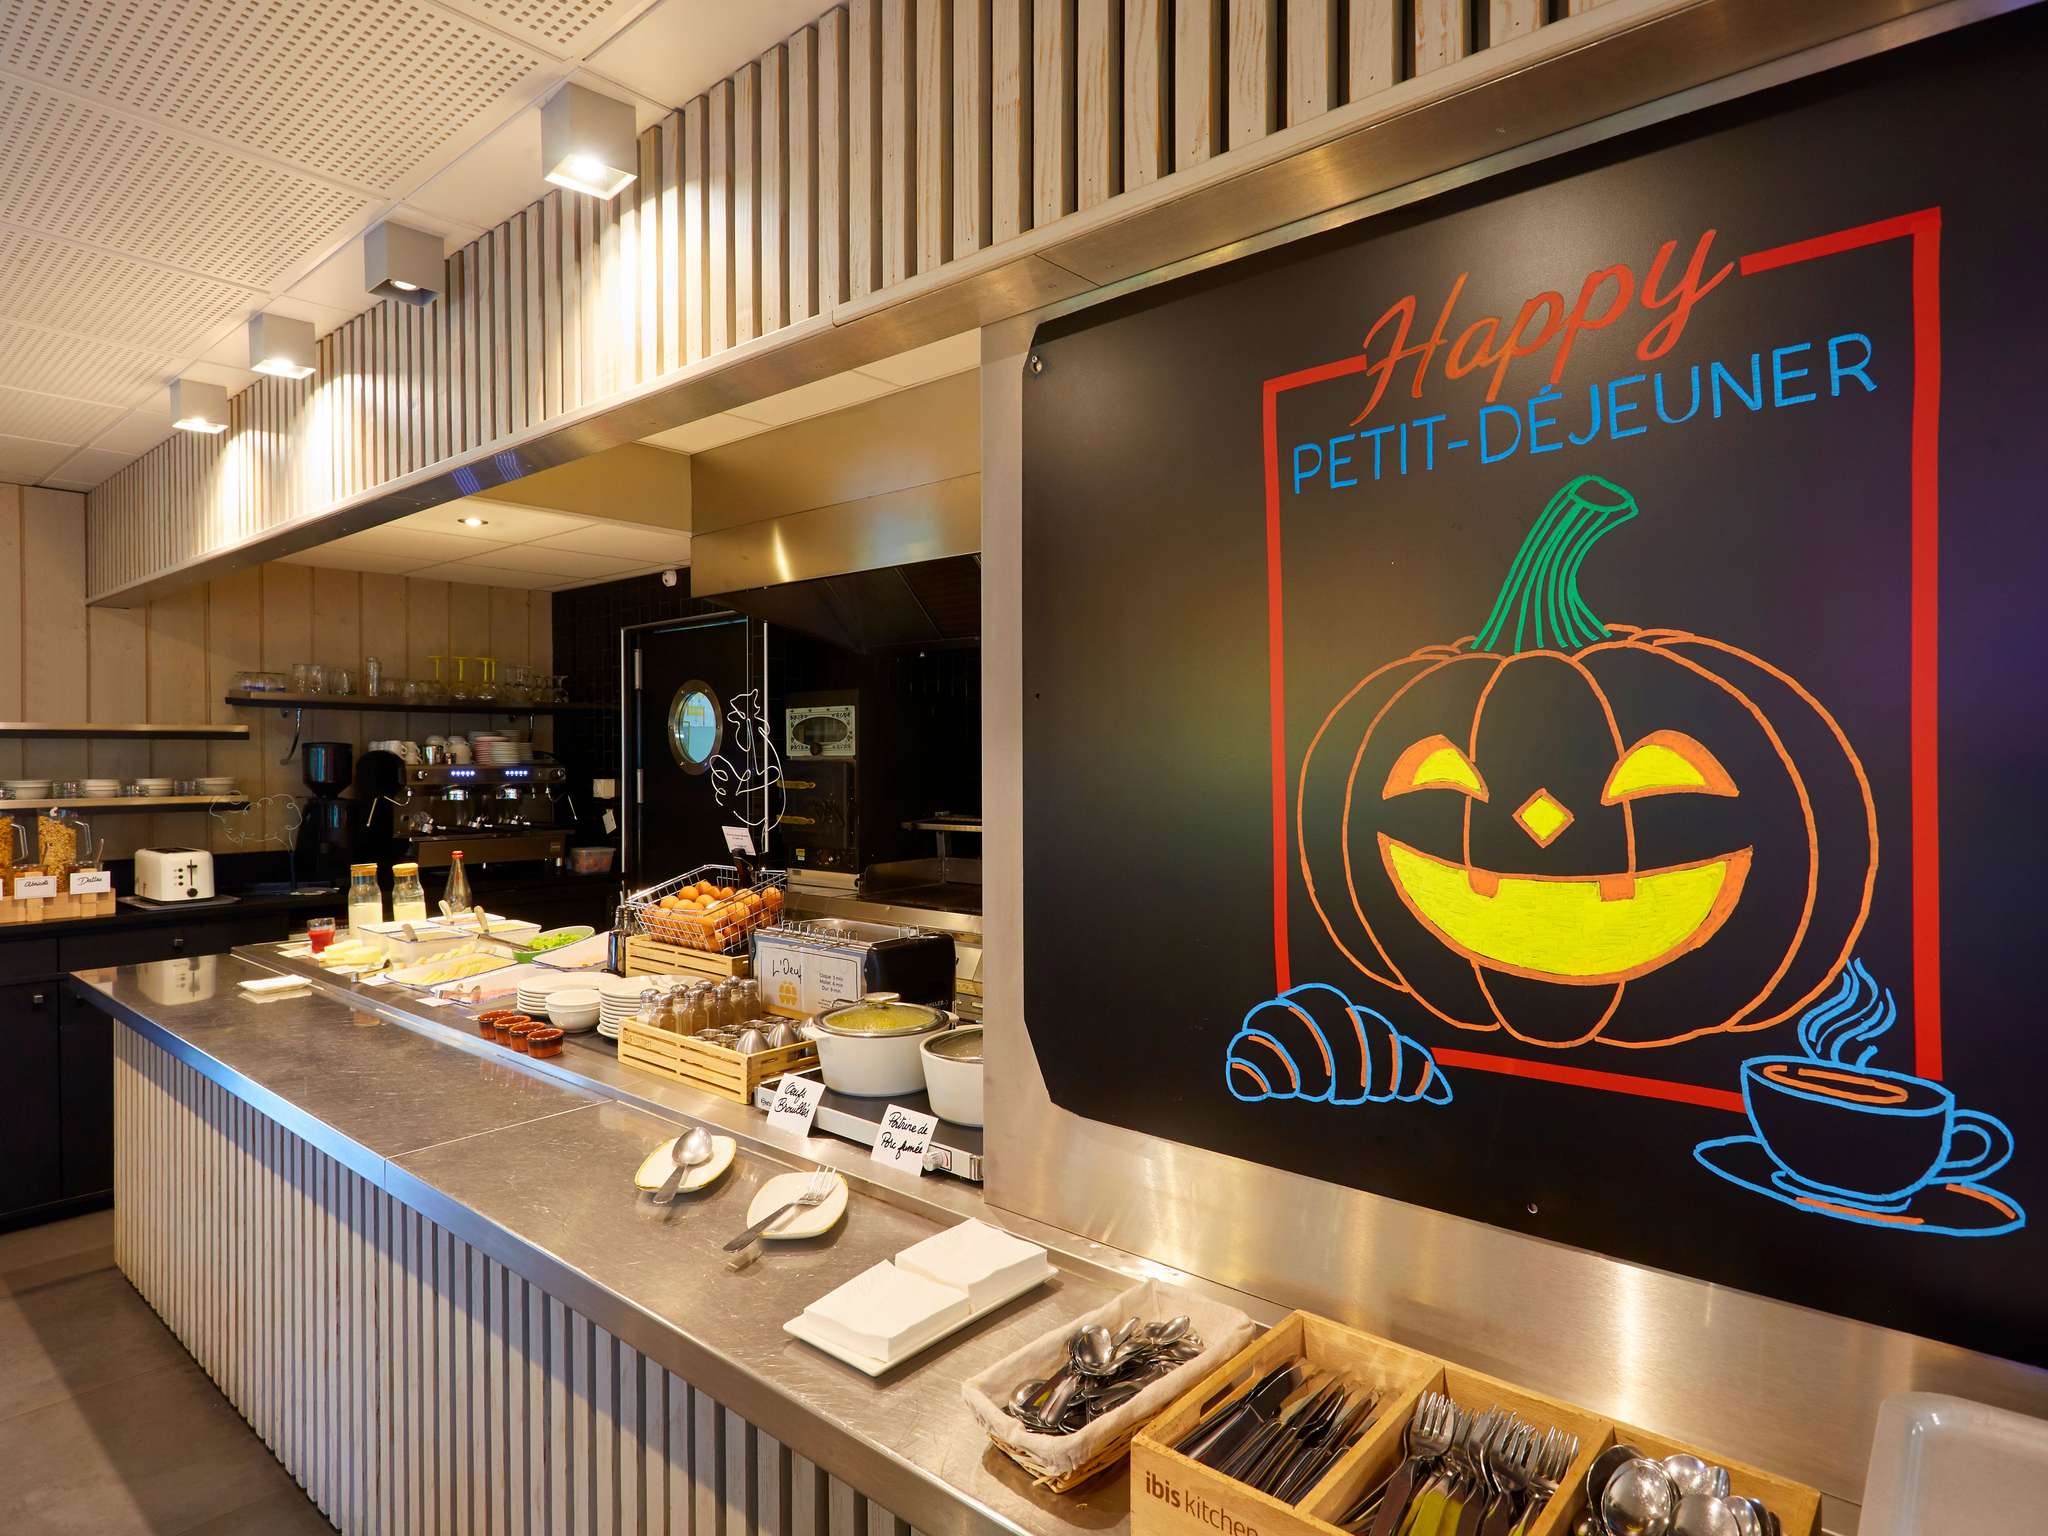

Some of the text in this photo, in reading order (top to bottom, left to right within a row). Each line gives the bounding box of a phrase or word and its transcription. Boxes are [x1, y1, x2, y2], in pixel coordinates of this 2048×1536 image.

[1349, 229, 1735, 427] Happy
[1292, 331, 1878, 494] PETIT-DÉJEUNER
[889, 1112, 929, 1135] Poitrine de
[881, 1131, 923, 1161] Porc fumée
[1146, 1471, 1181, 1508] ibis
